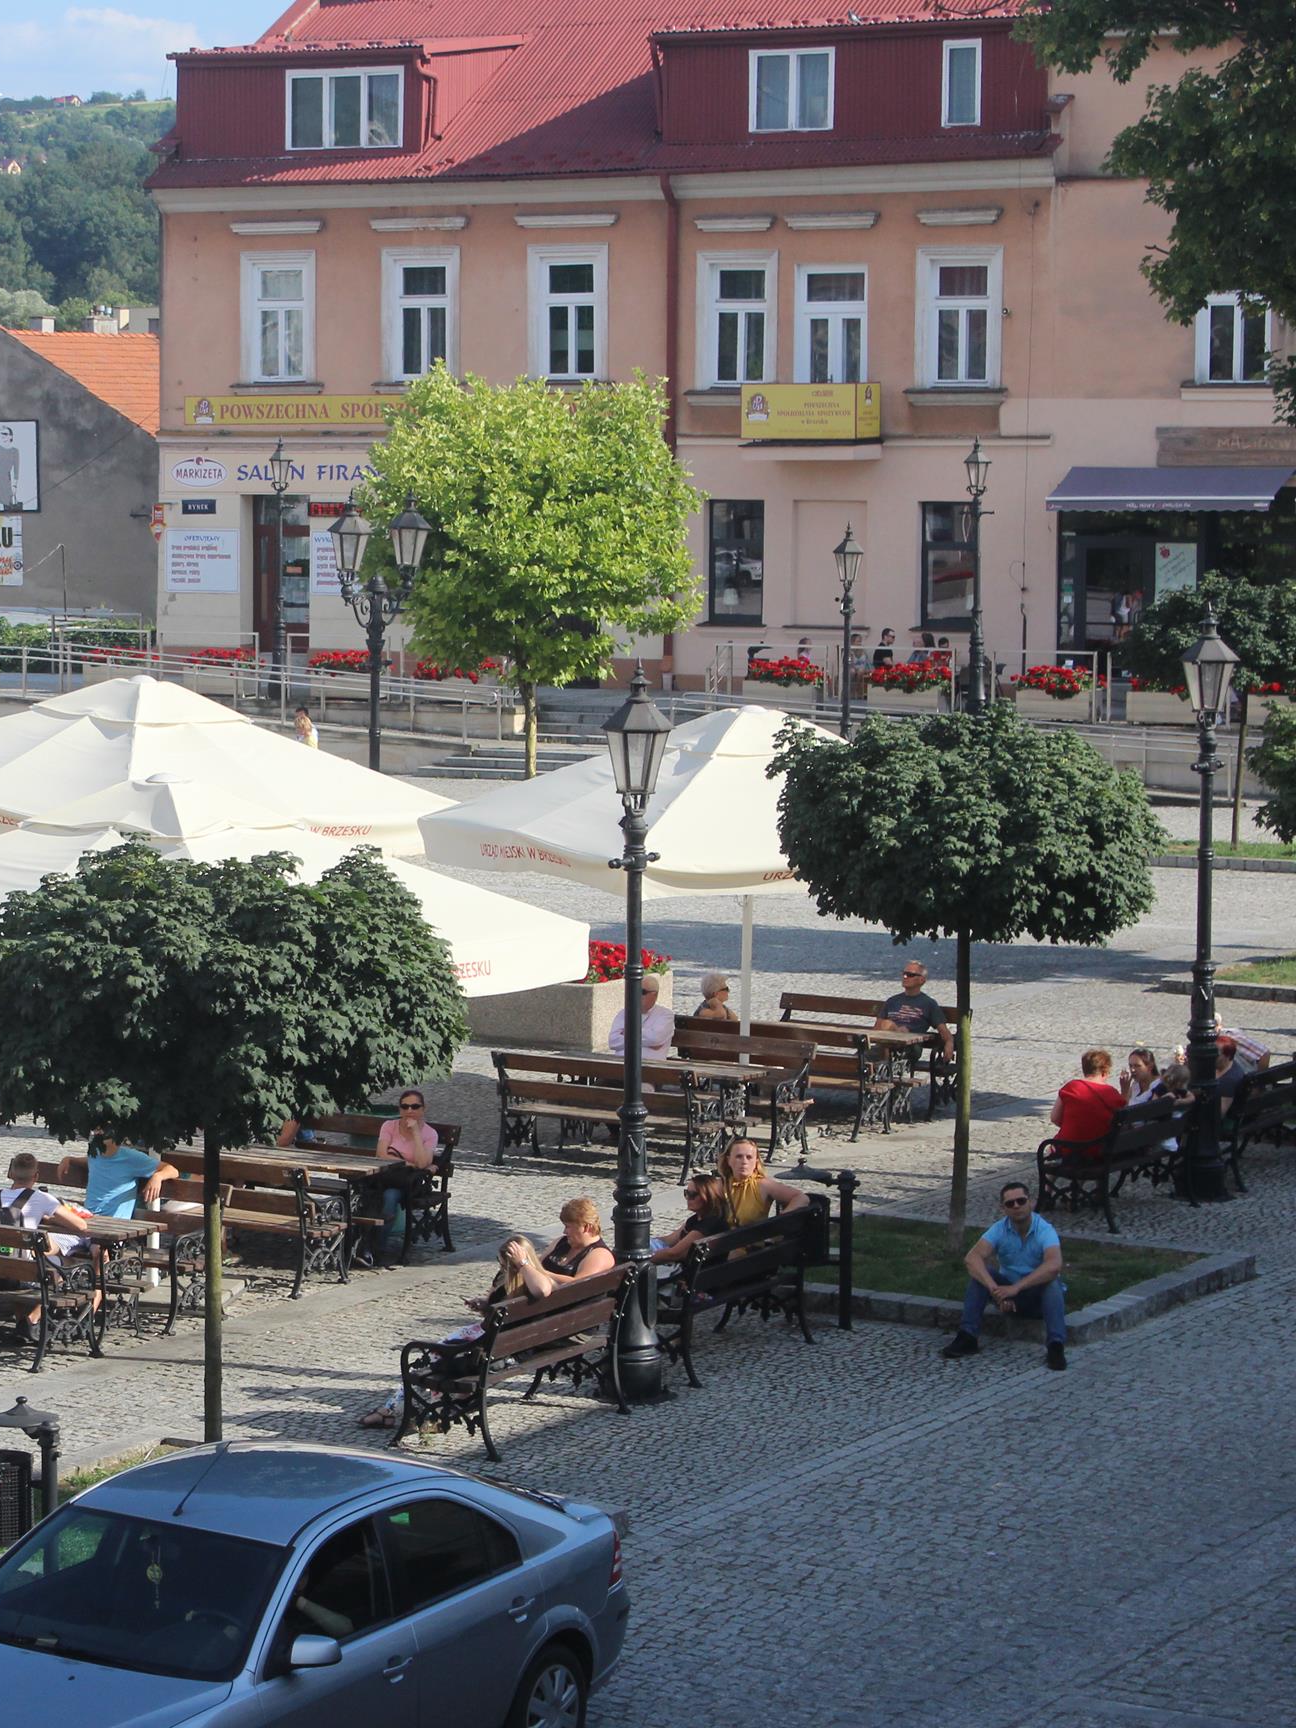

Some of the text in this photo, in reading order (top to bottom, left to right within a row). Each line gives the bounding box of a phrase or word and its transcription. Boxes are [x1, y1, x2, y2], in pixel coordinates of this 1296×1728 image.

[220, 402, 330, 420] POWSZECHNA
[175, 467, 223, 480] MARKIZETA
[237, 464, 305, 481] SALN
[321, 825, 372, 837] BRZESKU
[527, 847, 536, 860] W
